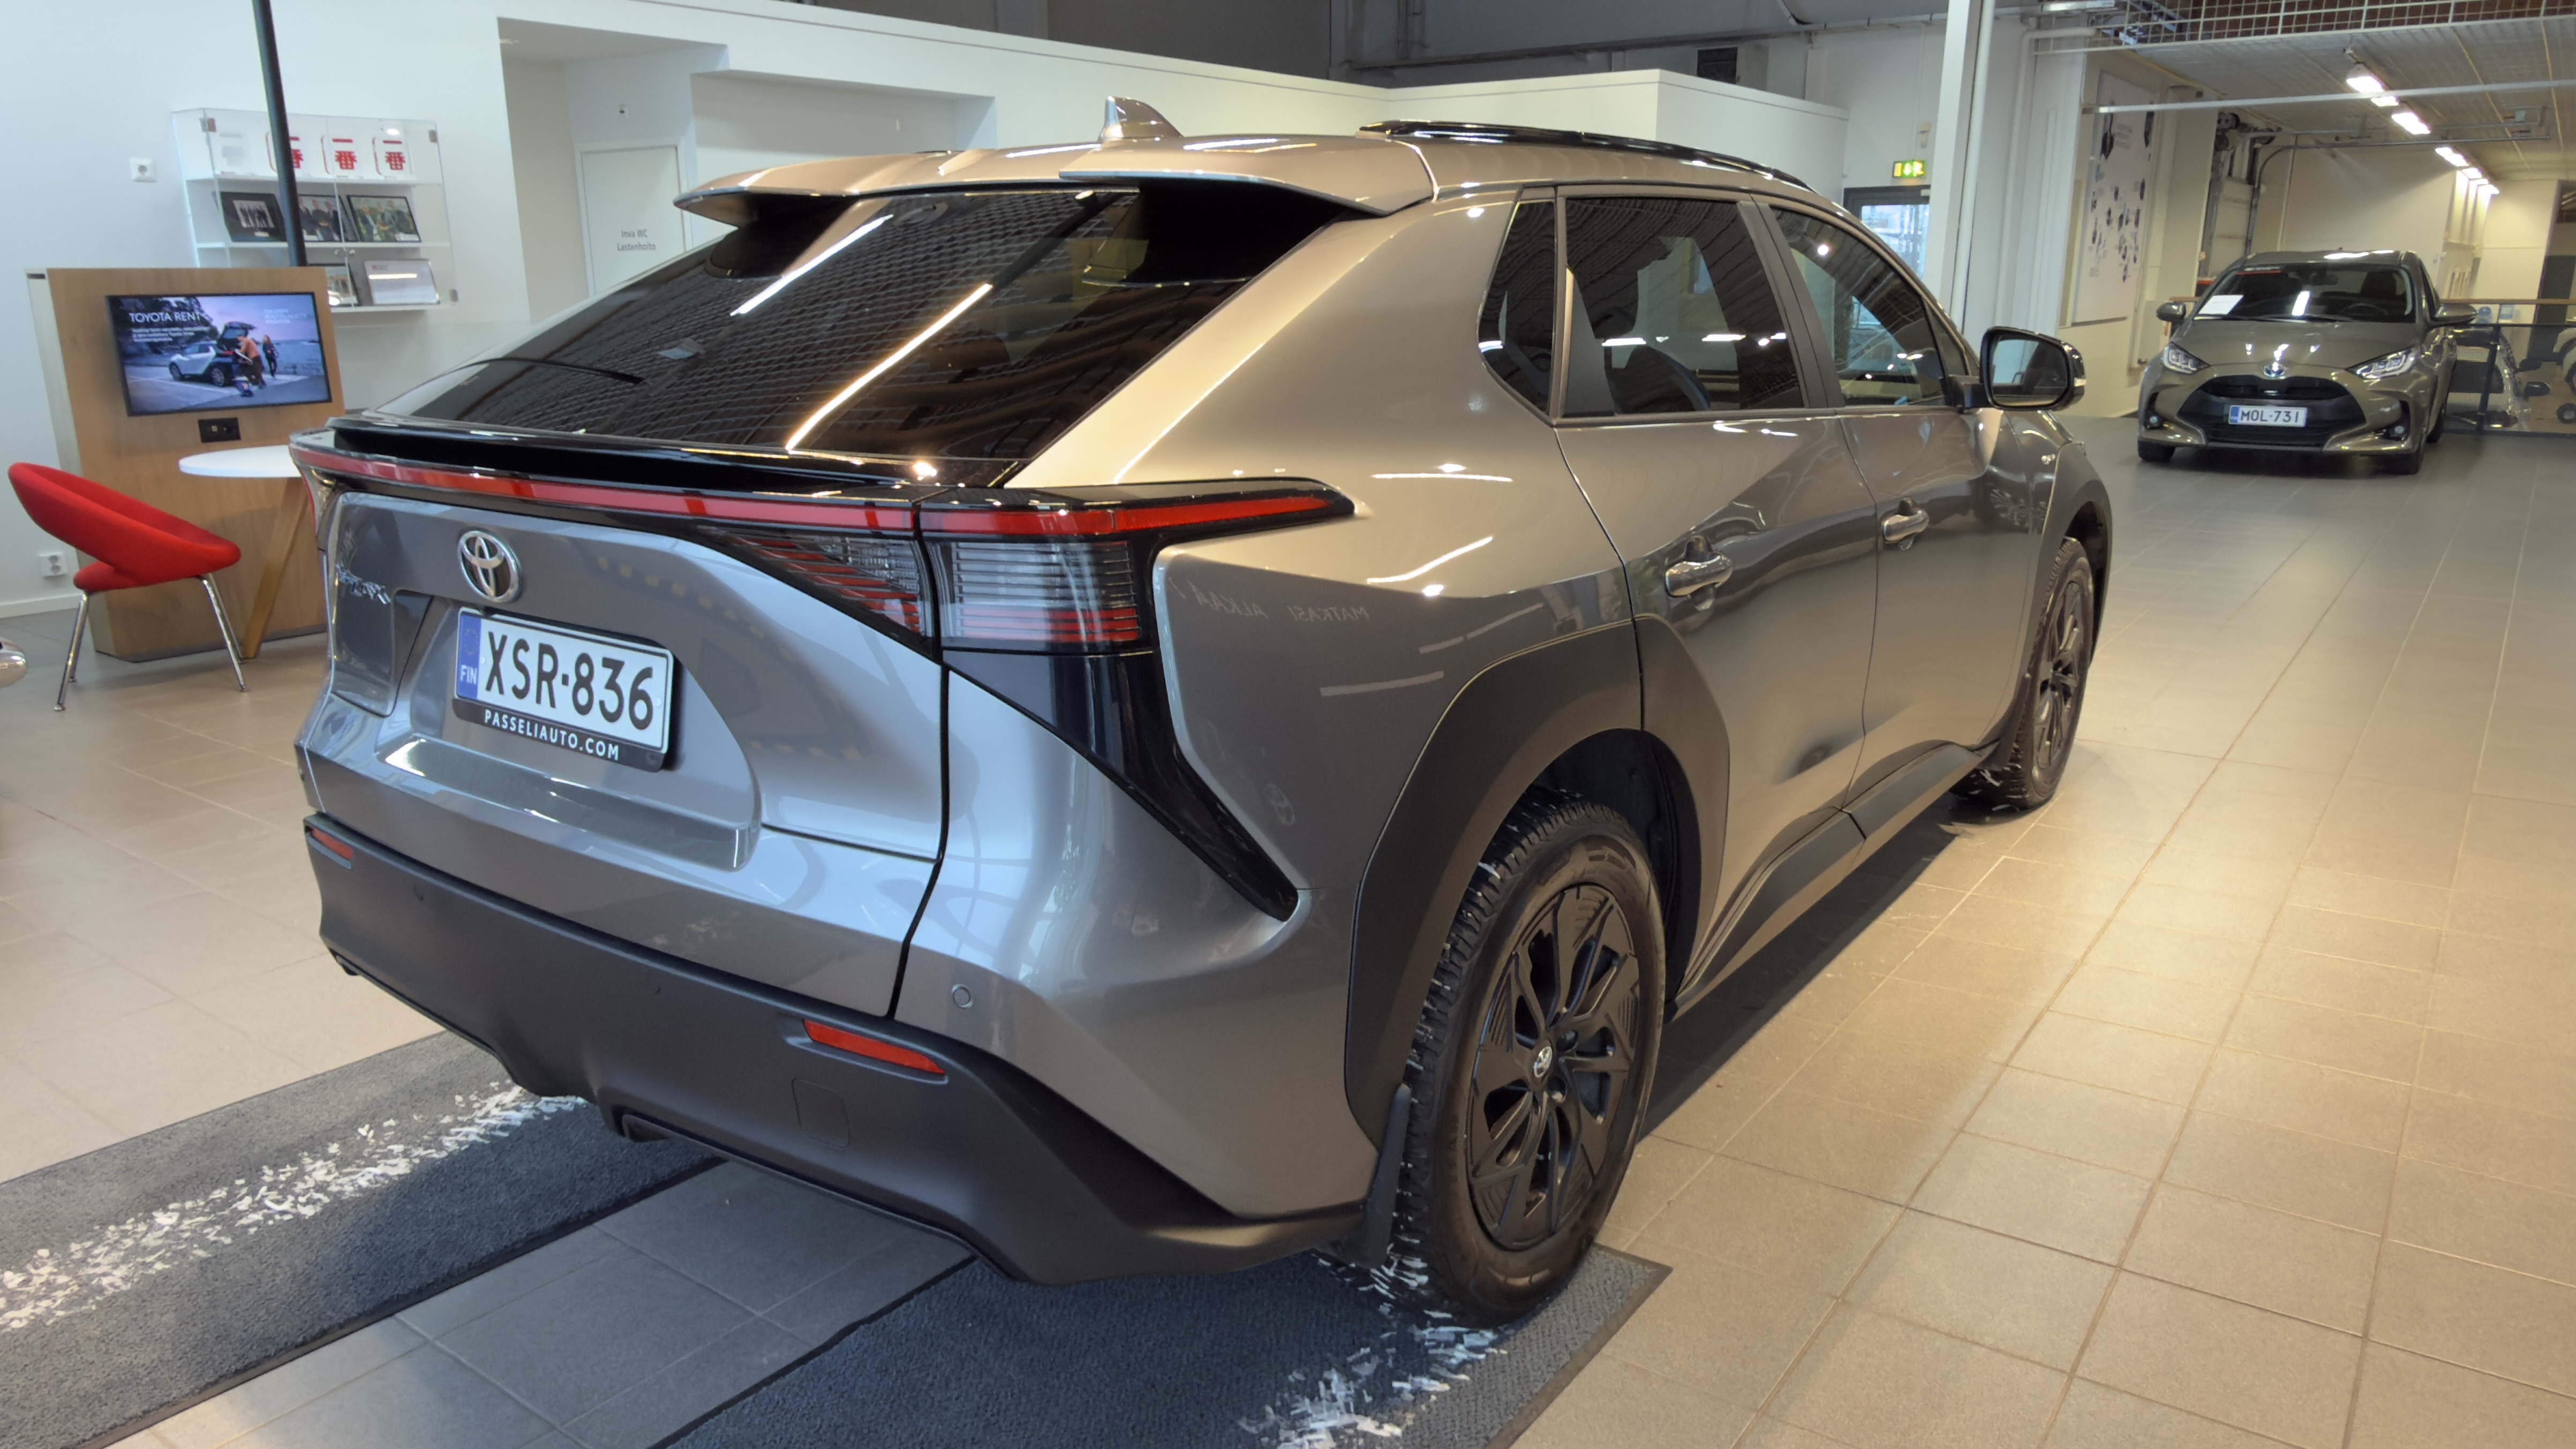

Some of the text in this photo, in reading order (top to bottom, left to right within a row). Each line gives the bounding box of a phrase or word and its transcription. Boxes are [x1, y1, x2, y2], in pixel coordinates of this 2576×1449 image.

[621, 229, 647, 238] Inva WC
[617, 242, 656, 251] Lastenhoito
[129, 311, 201, 323] TOYOTA RENT
[2240, 410, 2299, 423] MOL-731
[460, 665, 477, 685] FIN
[485, 631, 653, 731] XSR-836
[484, 709, 619, 761] PASSELIAUTO.COM
